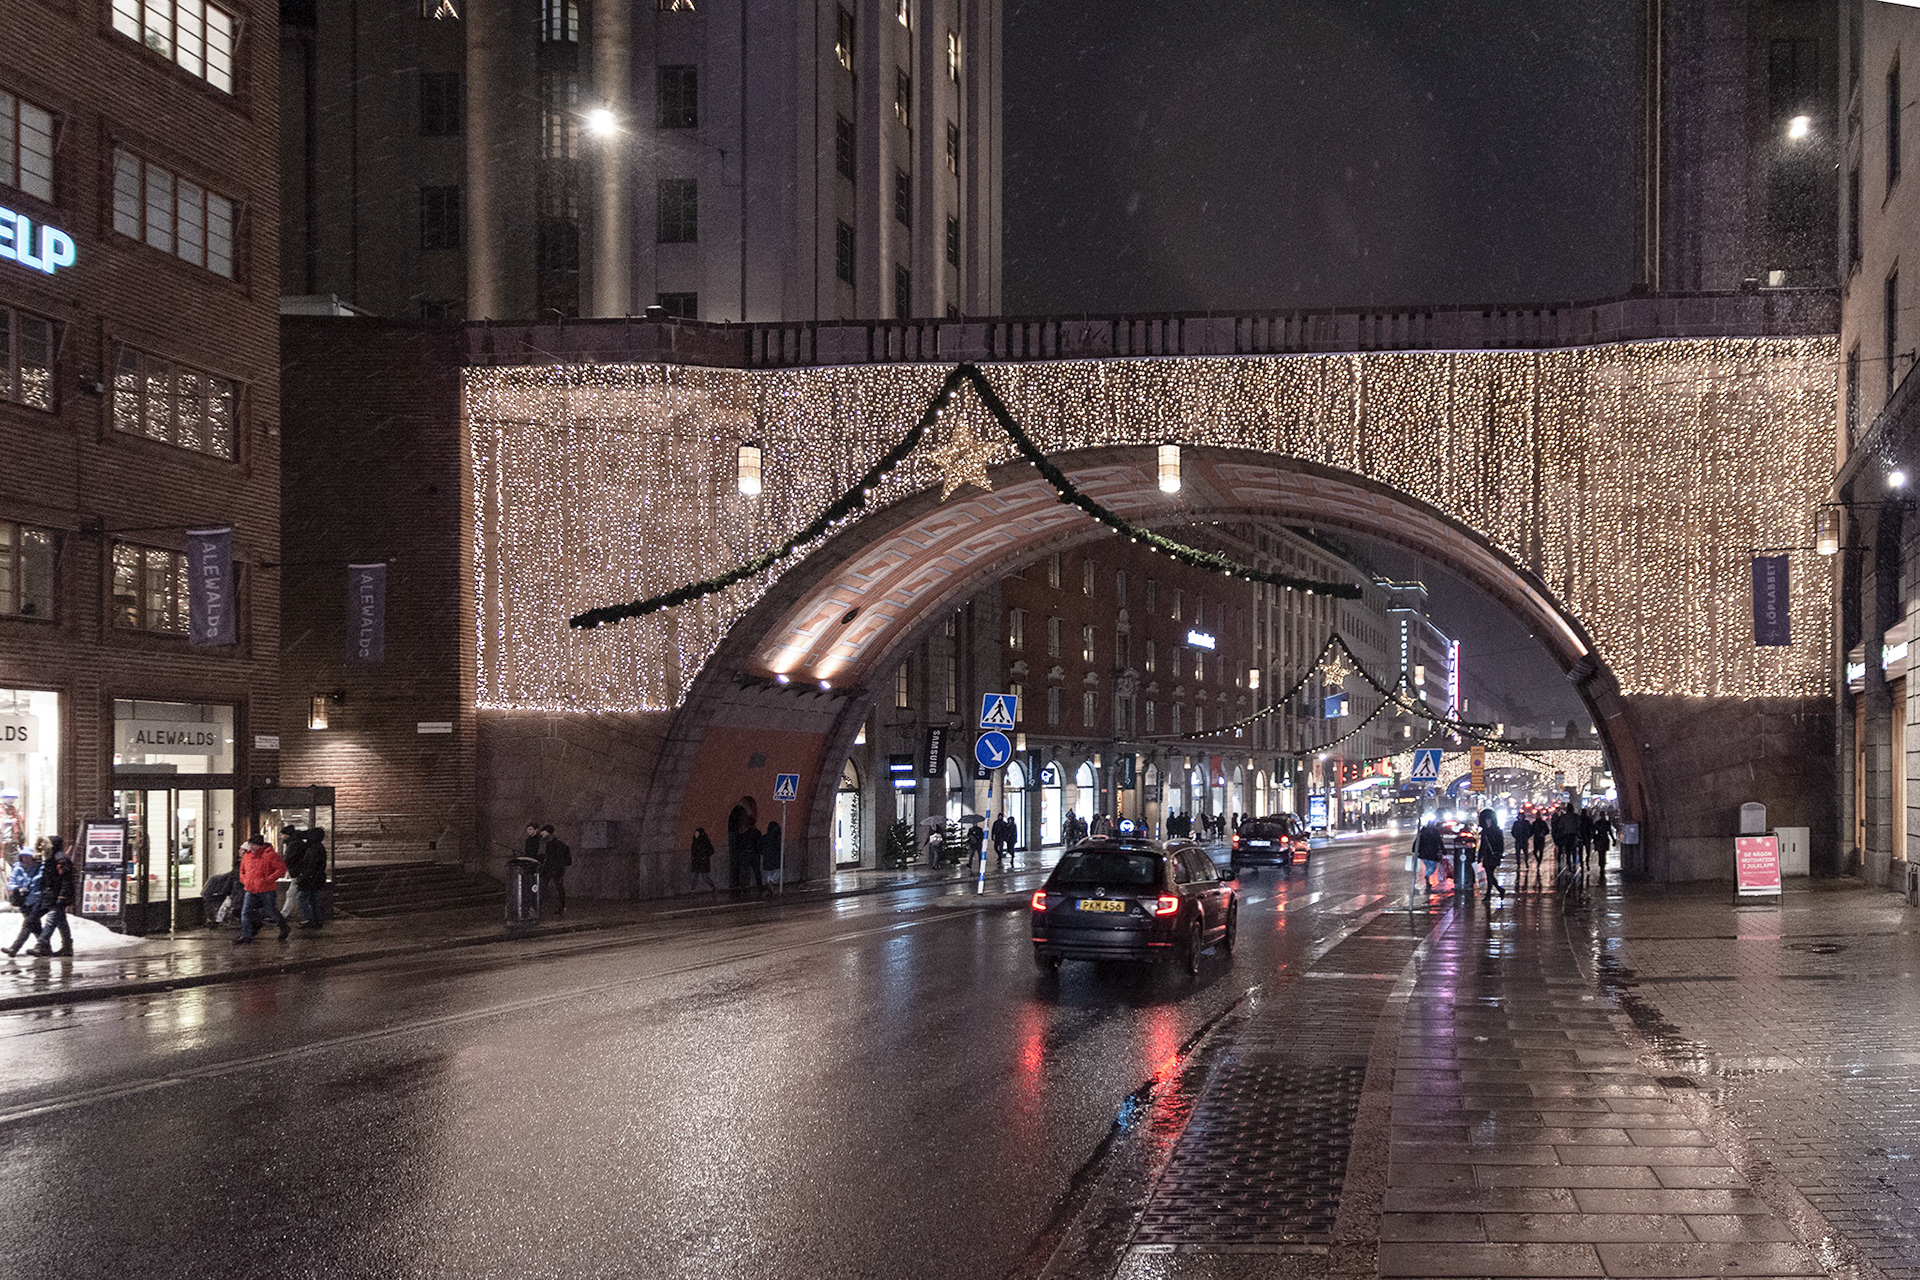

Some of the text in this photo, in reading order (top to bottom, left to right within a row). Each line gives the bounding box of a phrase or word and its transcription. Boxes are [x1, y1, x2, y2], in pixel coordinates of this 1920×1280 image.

[202, 542, 221, 638] ALEWALDS
[359, 574, 375, 657] ALEWALDS
[1766, 564, 1777, 625] LÖPLABBET
[136, 729, 215, 746] ALEWALDS
[928, 730, 941, 774] SAMSUNG
[1083, 901, 1122, 911] PKM 456
